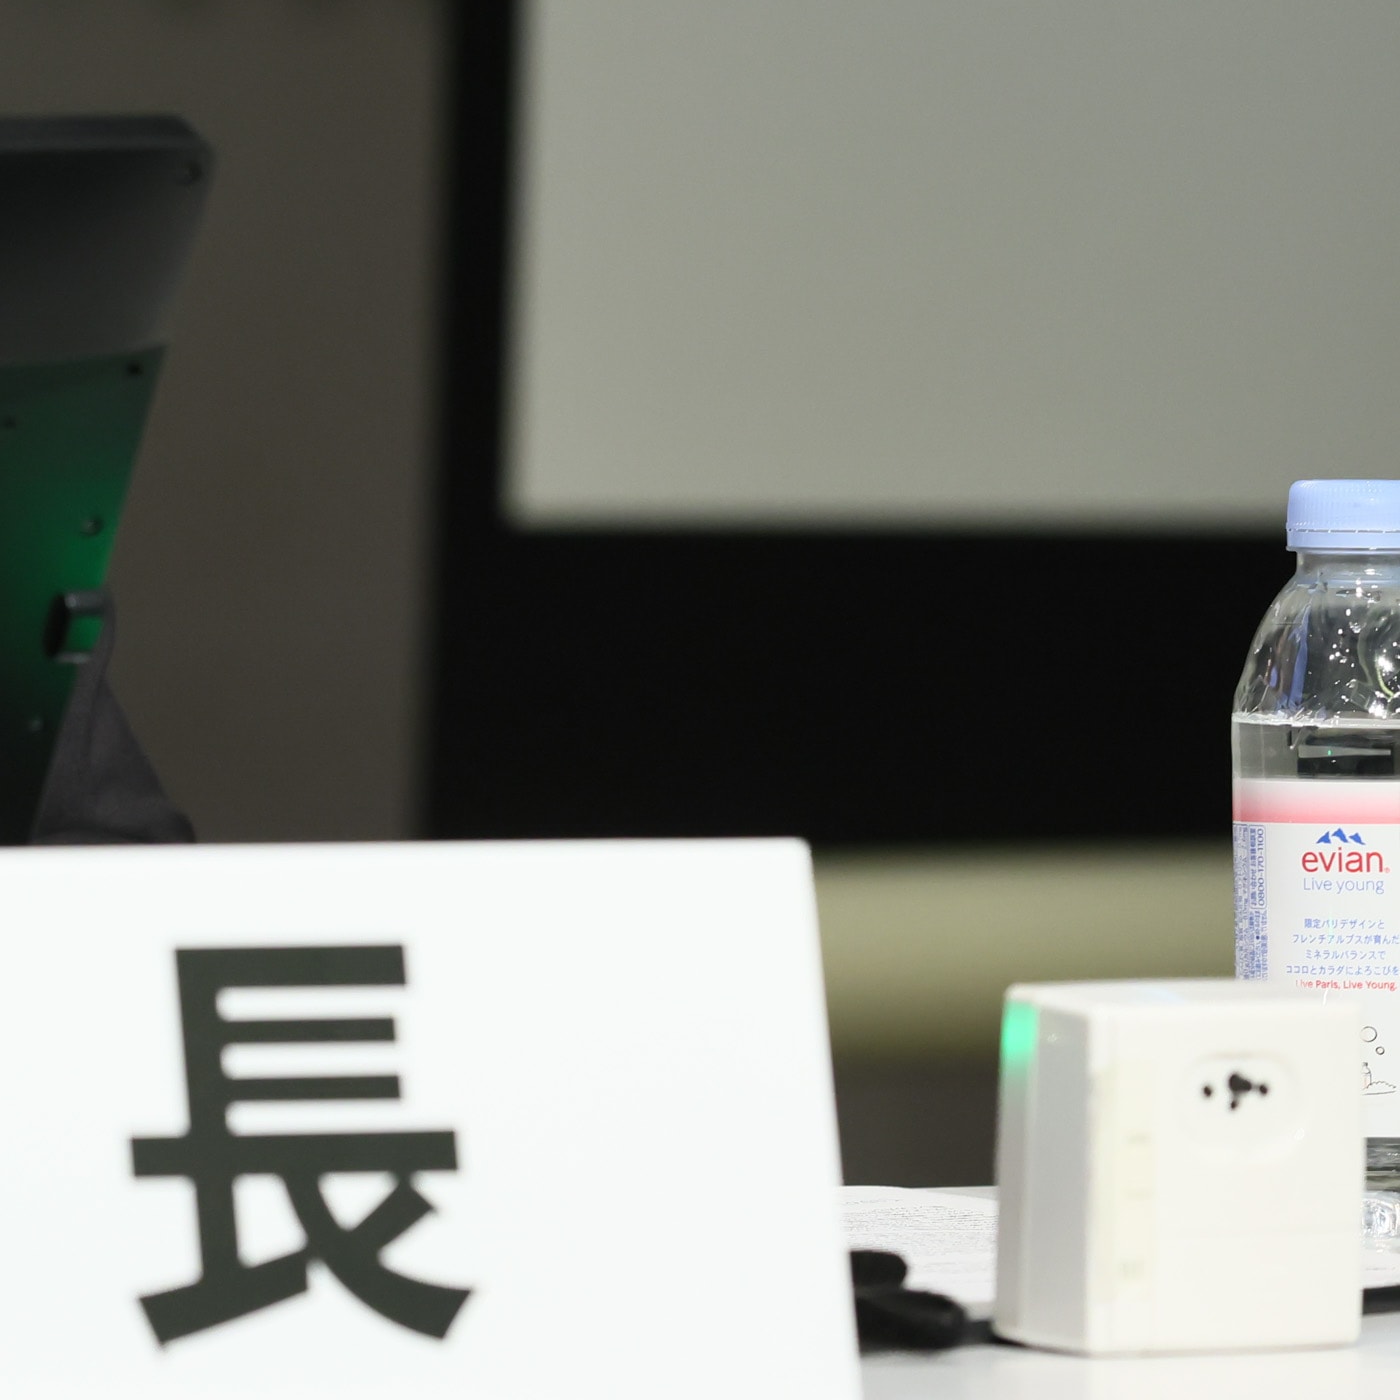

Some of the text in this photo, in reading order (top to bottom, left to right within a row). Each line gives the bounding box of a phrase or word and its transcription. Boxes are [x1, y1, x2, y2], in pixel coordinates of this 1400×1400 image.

[1257, 828, 1265, 906] 0800-170-1100
[1303, 878, 1385, 895] Live young
[1343, 980, 1363, 989] Live
